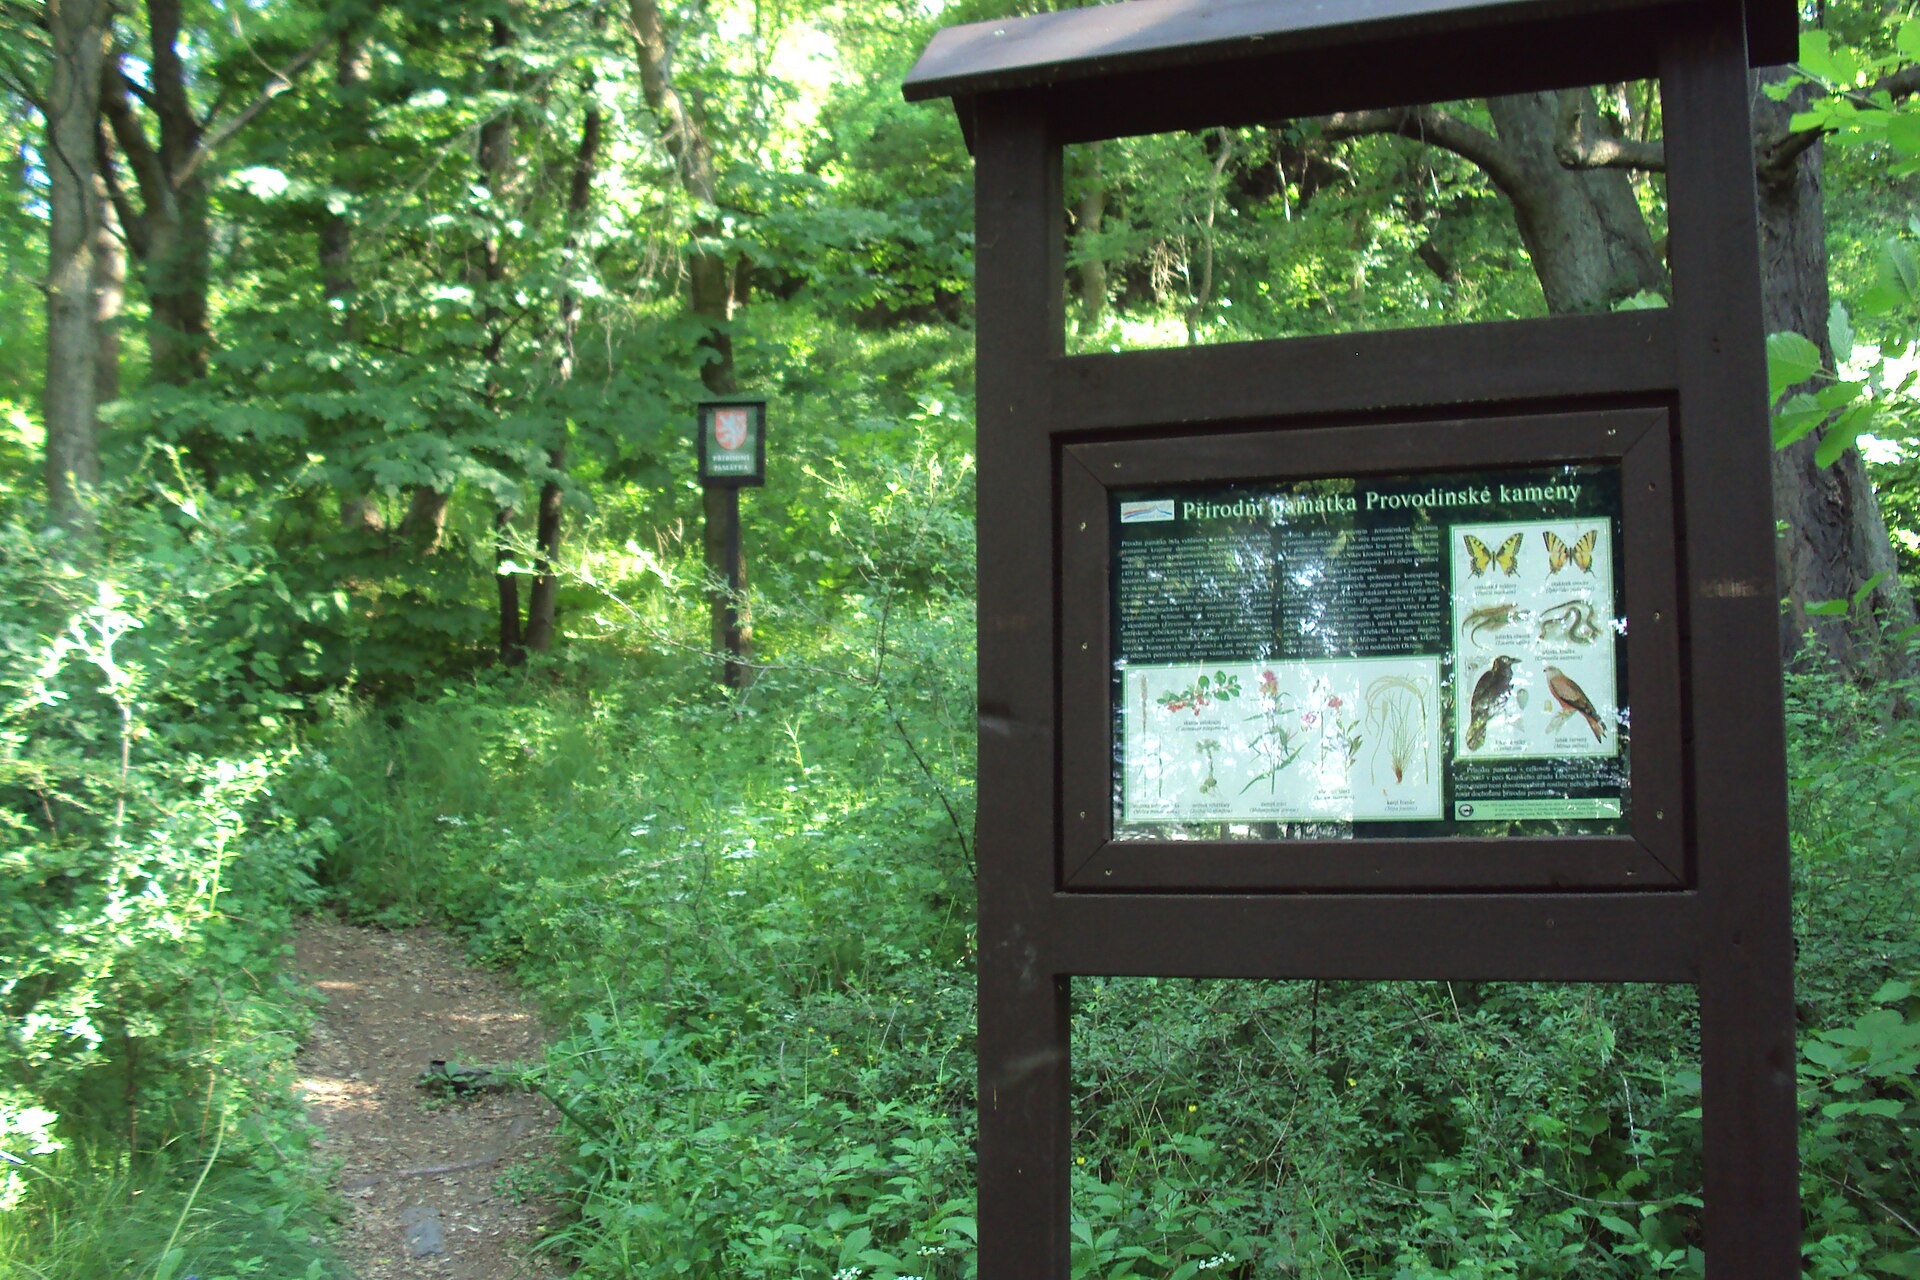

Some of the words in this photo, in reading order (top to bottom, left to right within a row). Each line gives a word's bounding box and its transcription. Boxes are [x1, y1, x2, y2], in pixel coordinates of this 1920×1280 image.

[1182, 499, 1264, 520] Přírodní
[1272, 493, 1358, 520] památka
[1366, 486, 1492, 510] Provodínské
[1500, 484, 1582, 503] kameny
